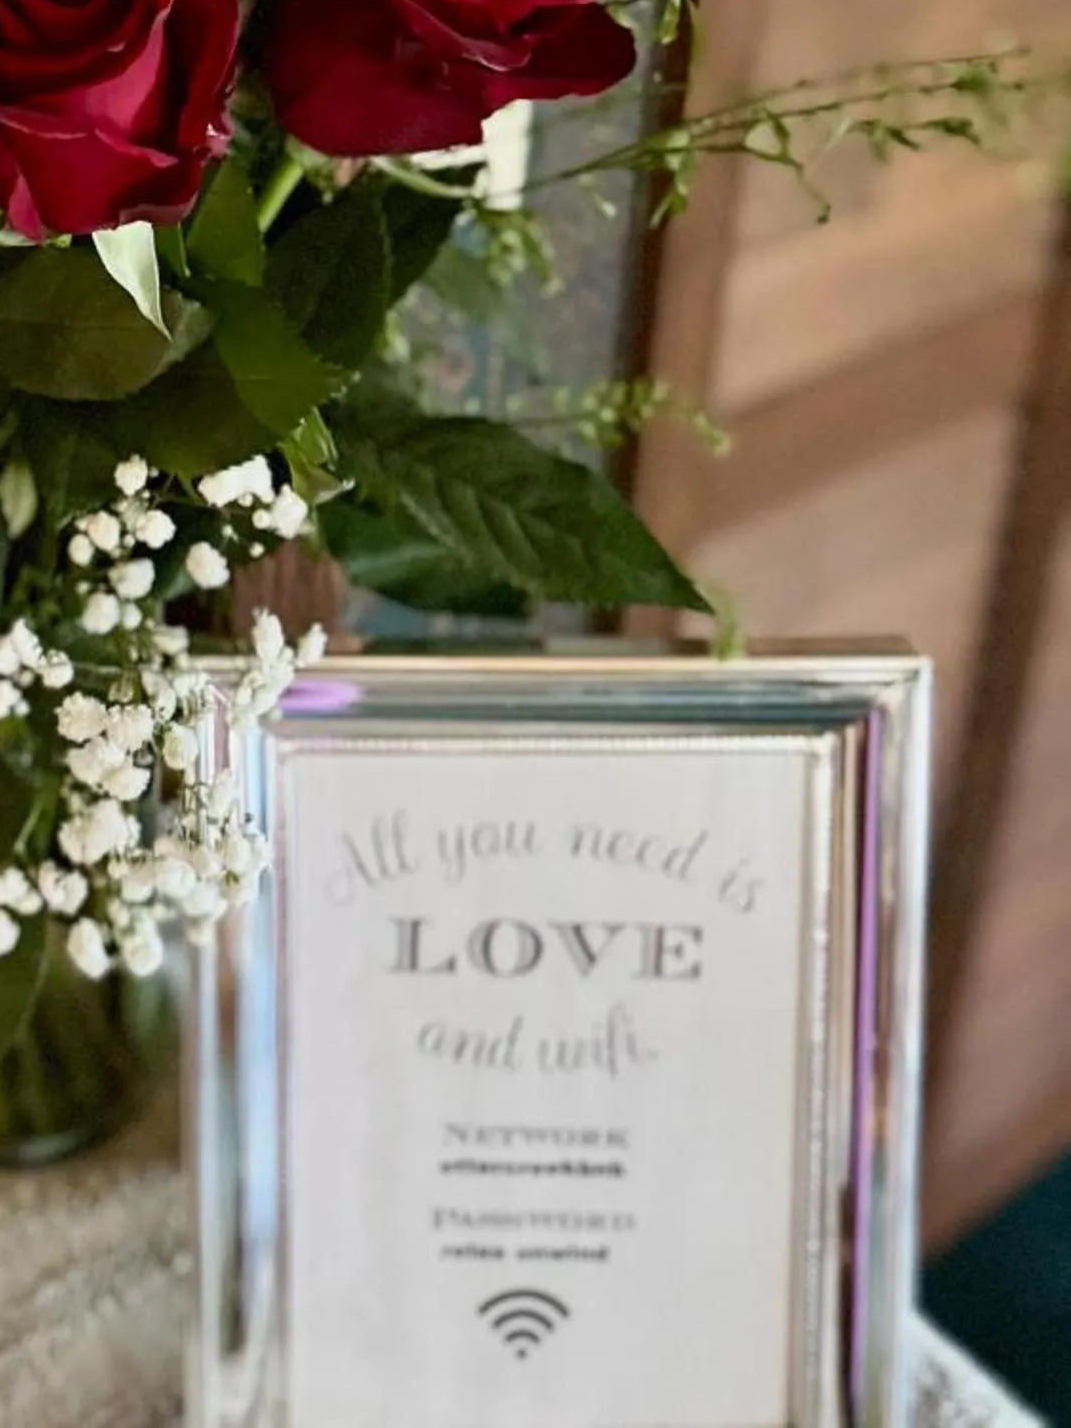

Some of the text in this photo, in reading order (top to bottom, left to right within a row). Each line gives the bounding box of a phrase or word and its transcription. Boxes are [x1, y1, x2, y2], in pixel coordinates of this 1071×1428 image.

[326, 808, 766, 914] All you need is
[389, 916, 703, 980] LOVE
[417, 1015, 522, 1072] and
